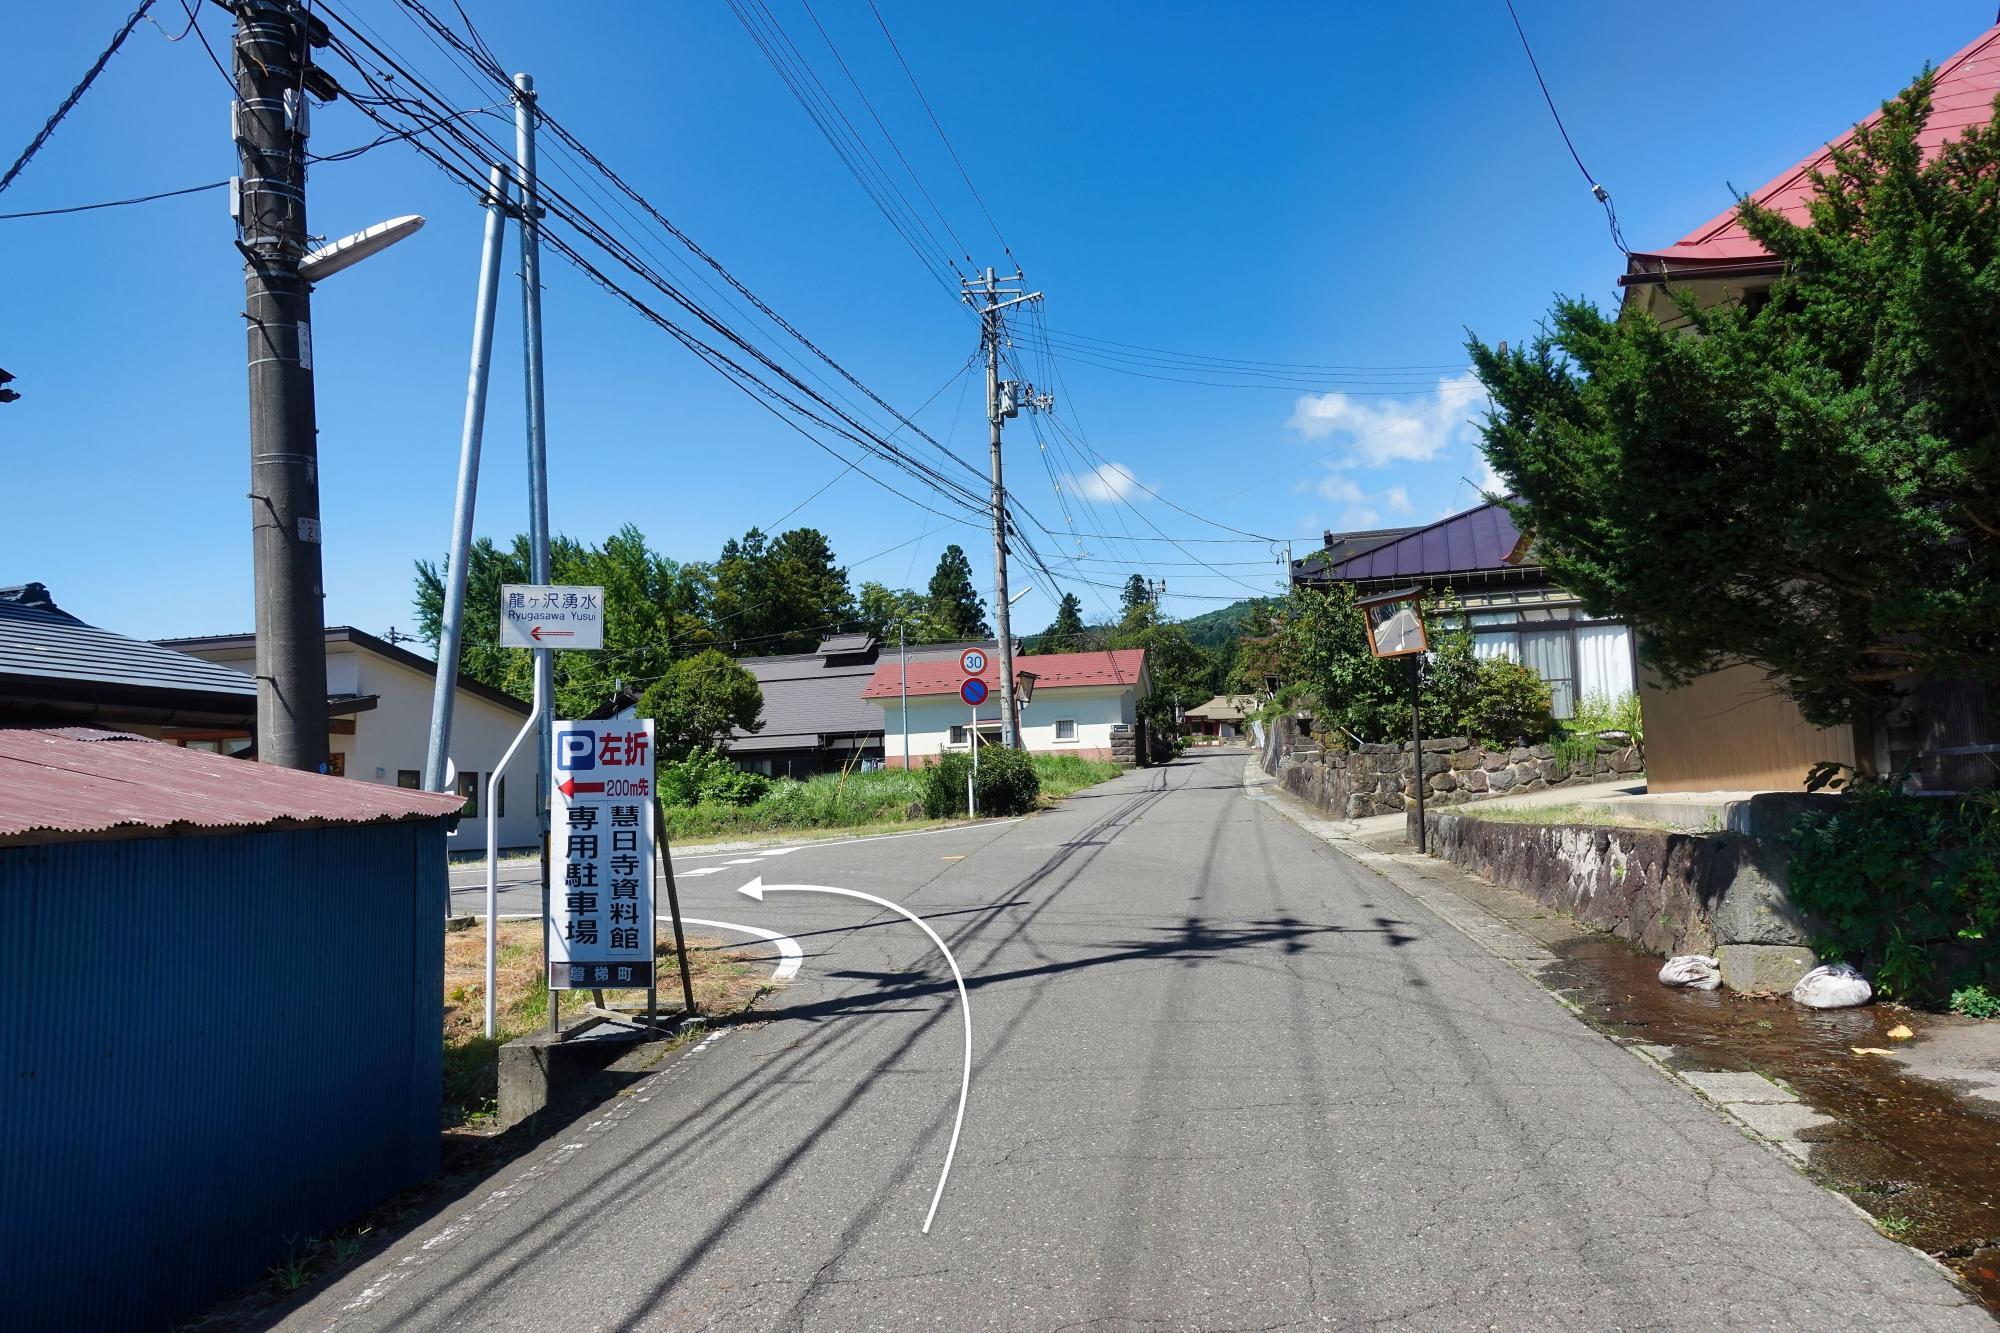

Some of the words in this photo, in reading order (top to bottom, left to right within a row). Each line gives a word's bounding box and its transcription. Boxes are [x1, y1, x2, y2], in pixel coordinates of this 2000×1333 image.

[508, 610, 565, 621] Ryugasawa
[571, 611, 596, 621] Yusui
[966, 656, 982, 668] 30
[562, 735, 593, 766] P
[598, 731, 649, 766] 左折
[606, 778, 649, 797] 200m先
[565, 805, 599, 945] 専用駐車場
[610, 805, 640, 950] 慧日寺資料館
[569, 966, 633, 982] 磐梯町
